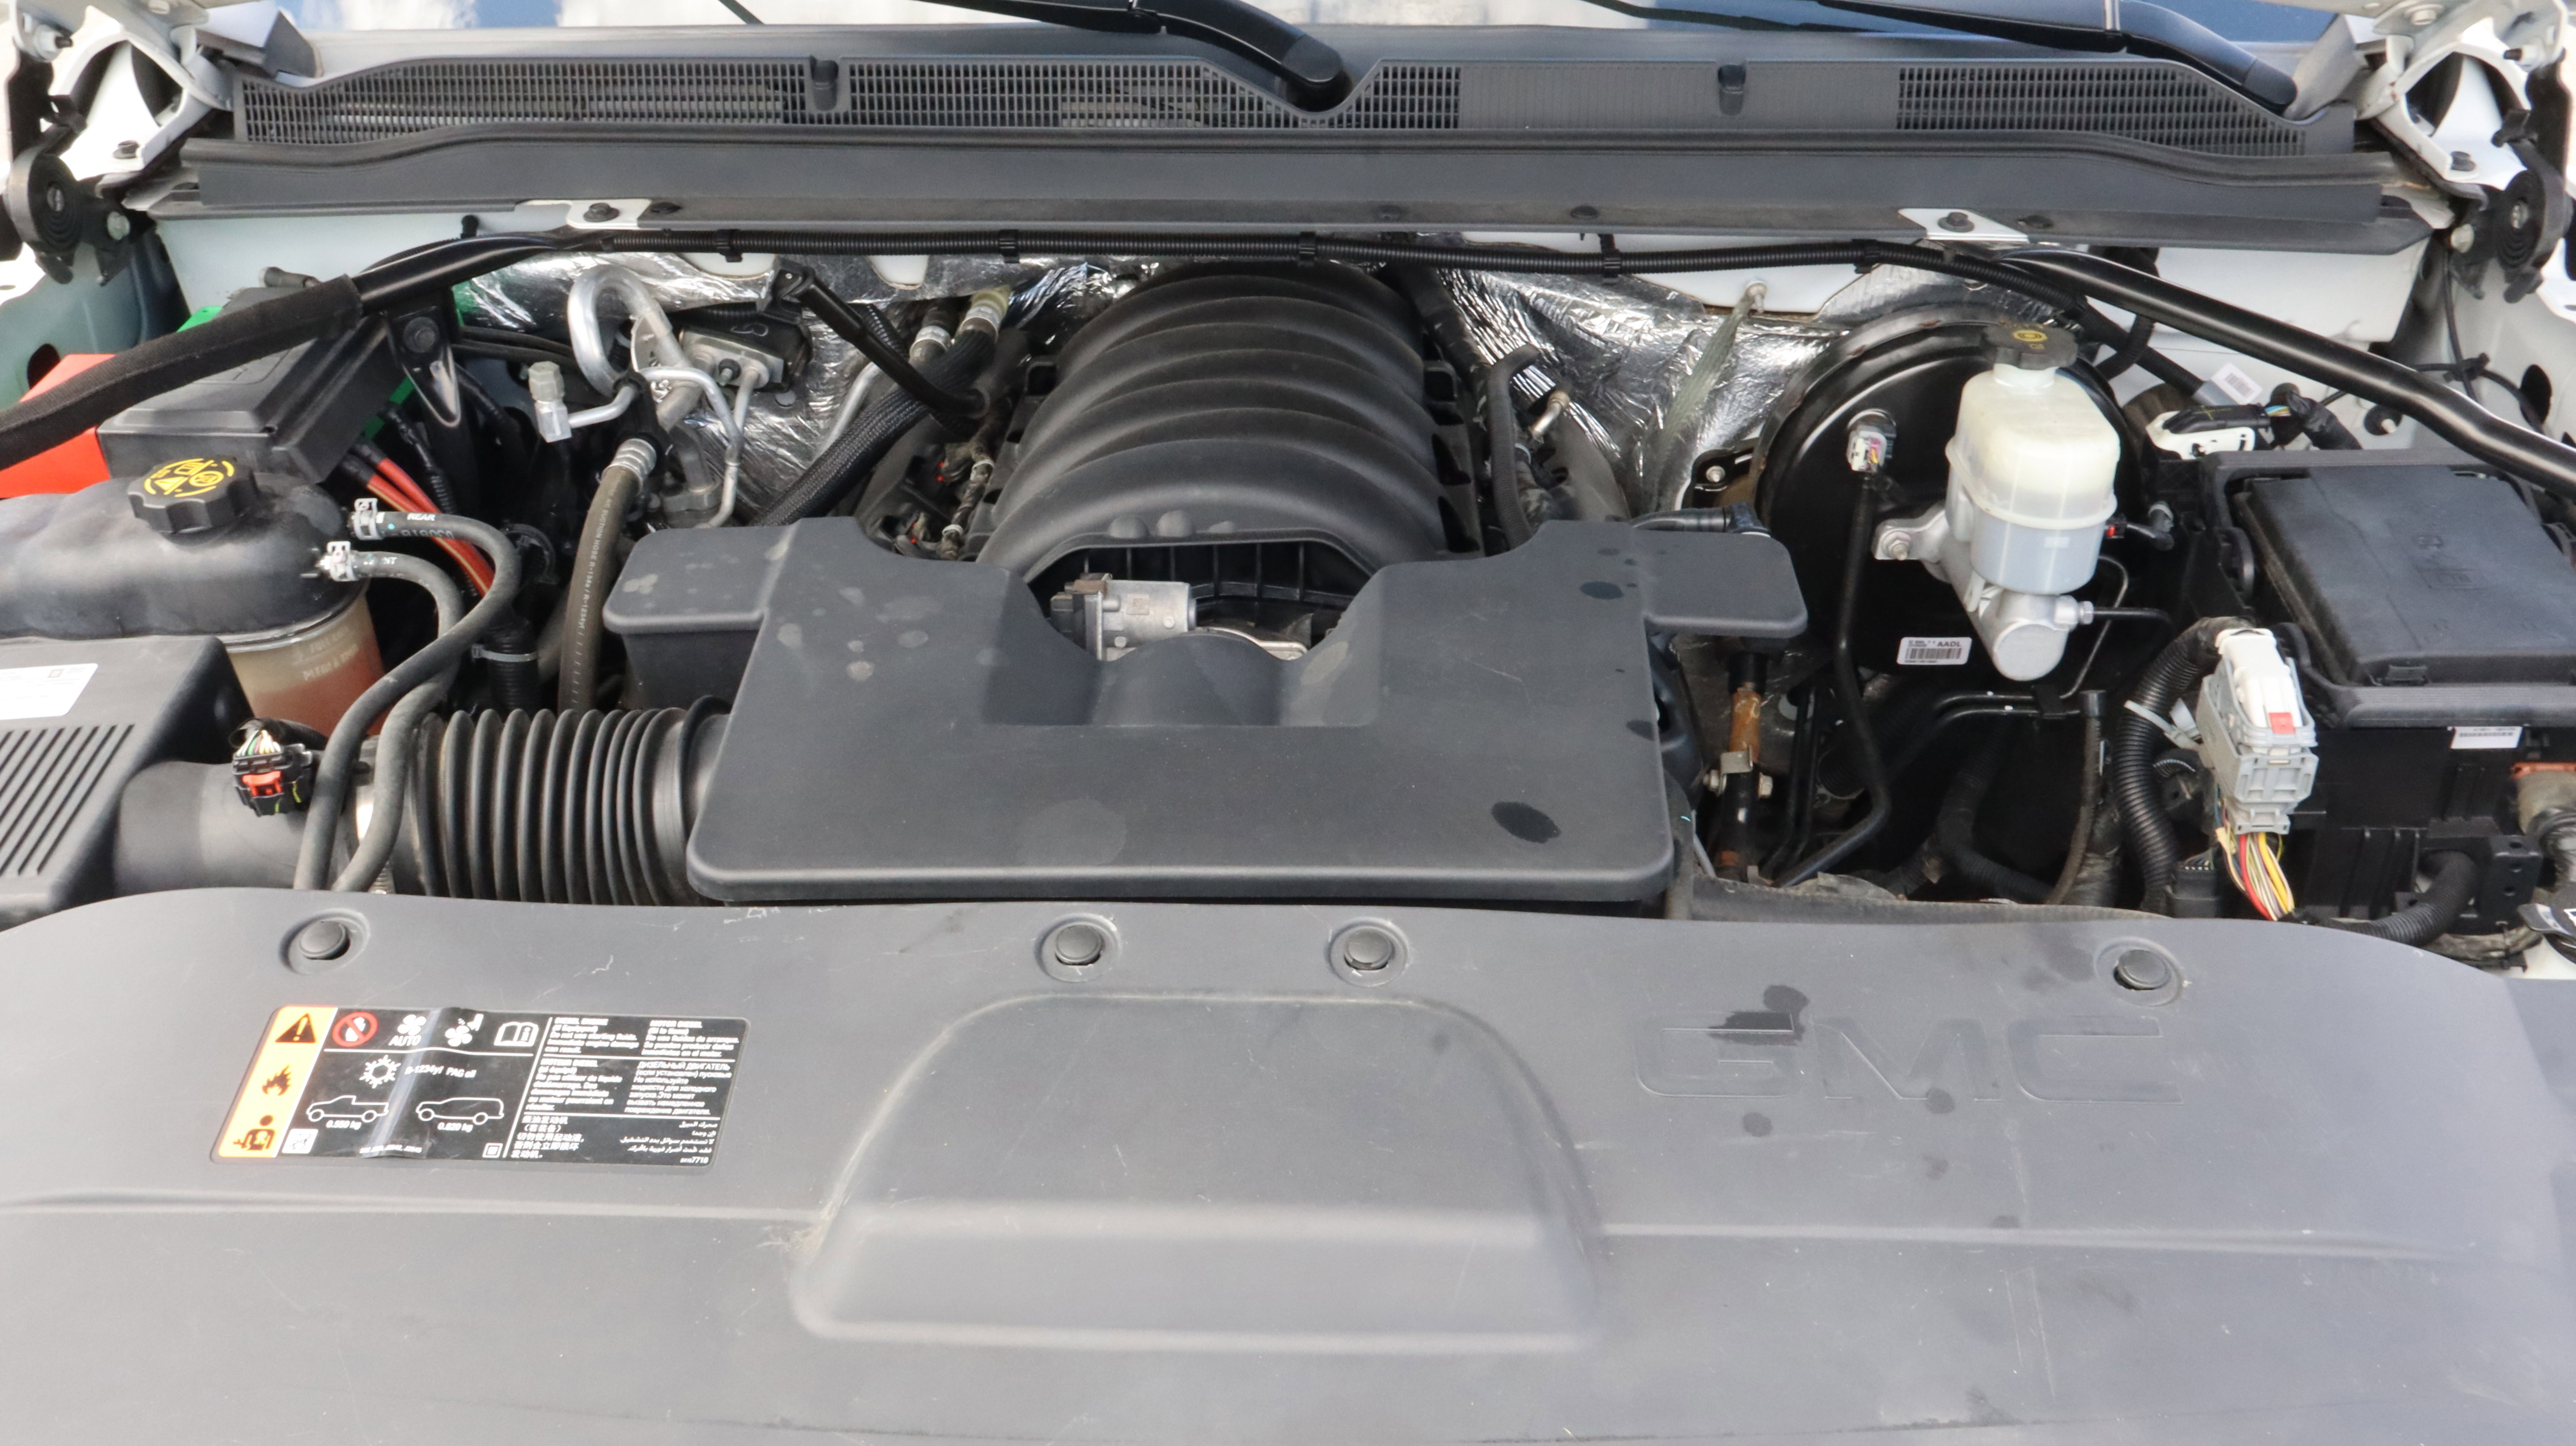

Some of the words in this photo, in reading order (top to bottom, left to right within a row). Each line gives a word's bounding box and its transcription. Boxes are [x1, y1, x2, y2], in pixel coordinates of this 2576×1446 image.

[407, 513, 436, 521] REAR
[596, 509, 609, 538] SUCTION
[590, 539, 601, 560] HOSE
[388, 1035, 422, 1046] AUTO
[588, 1033, 615, 1041] starting
[610, 1041, 639, 1049] damage
[1634, 1010, 2183, 1105] GMC
[405, 1064, 444, 1075] R-1234yf
[446, 1067, 465, 1077] PAG
[464, 1069, 477, 1078] oil
[637, 1061, 686, 1069] ДИЗЕЛЬНЫЙ
[685, 1062, 731, 1071] ДВИГАТЕЛЬ
[656, 1070, 699, 1079] установлен)
[644, 1077, 690, 1086] используйте
[326, 1120, 350, 1128] 0.550
[350, 1121, 362, 1130] kg
[461, 1123, 473, 1132] kg
